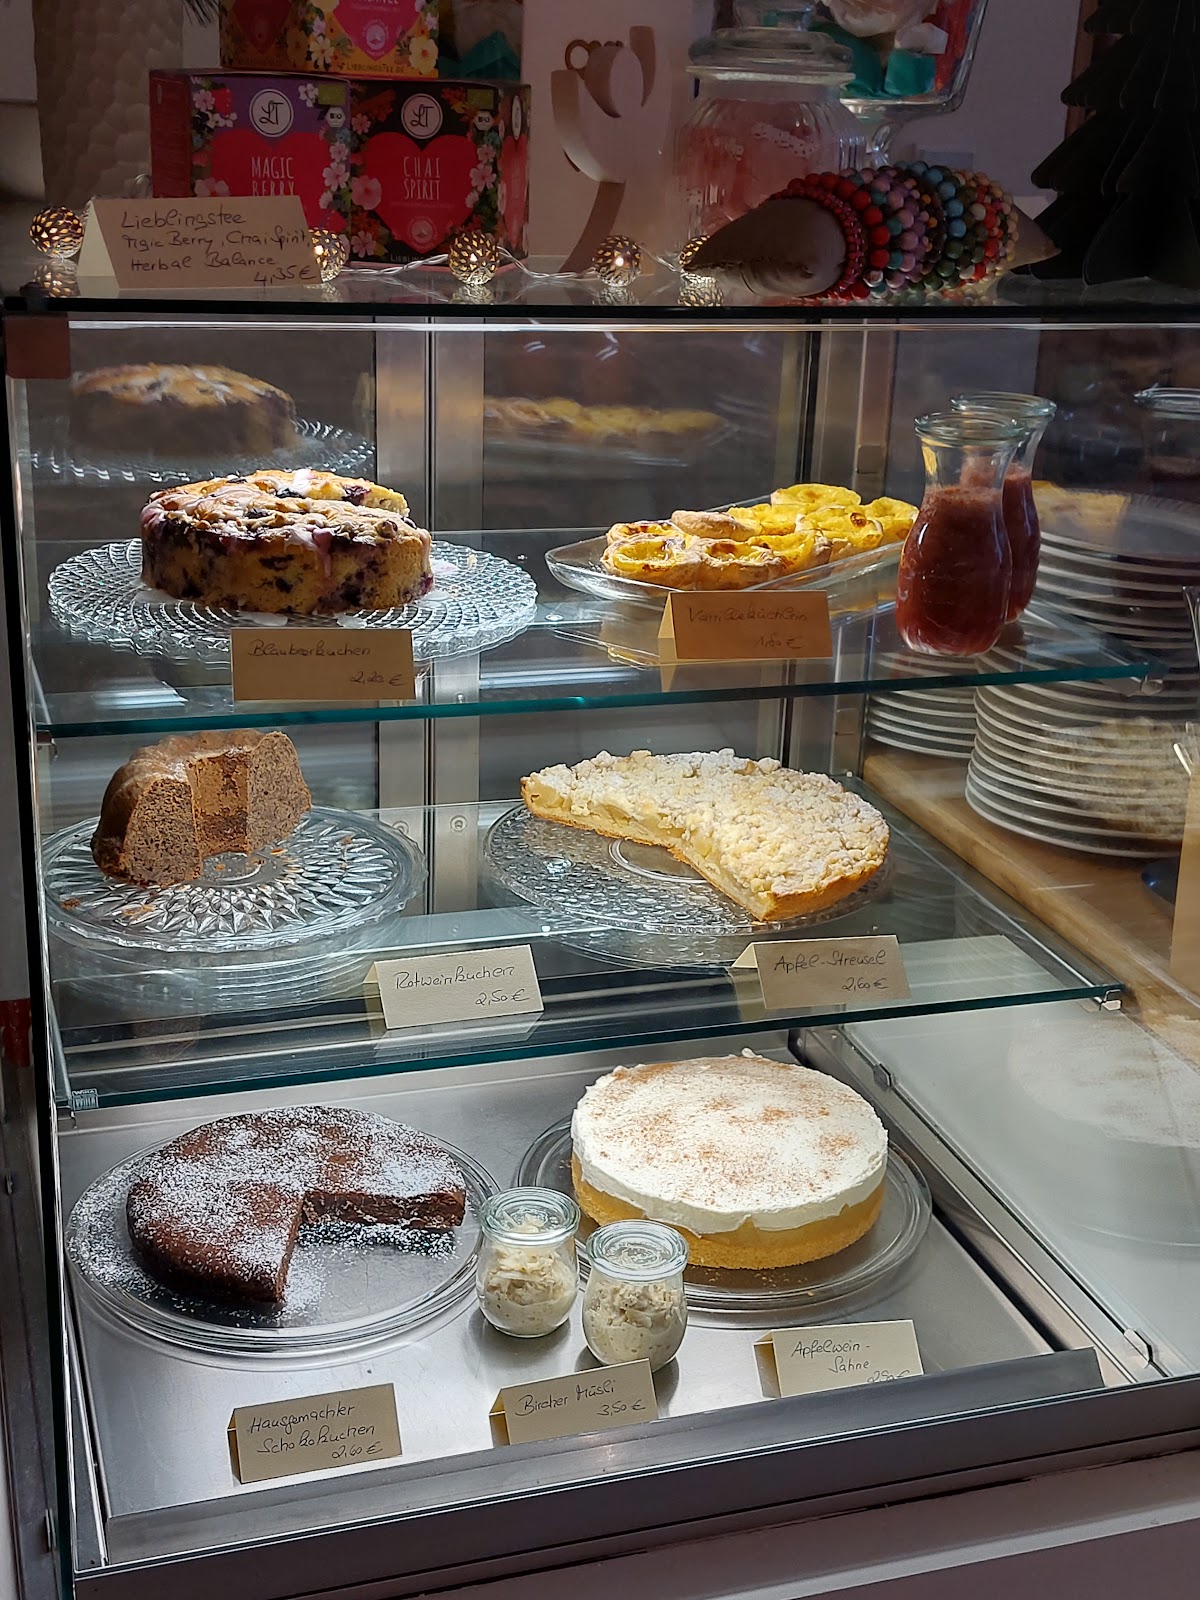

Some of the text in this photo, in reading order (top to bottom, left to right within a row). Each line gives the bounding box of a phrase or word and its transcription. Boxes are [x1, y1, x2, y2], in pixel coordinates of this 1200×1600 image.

[251, 156, 295, 179] MAGIC
[403, 155, 441, 178] CHAI
[252, 181, 295, 197] BERRY
[403, 178, 441, 200] SPIRIT
[121, 204, 246, 231] Lieblingstee
[131, 251, 277, 272] Herbal Balance
[828, 1355, 871, 1374] Sahne
[514, 1379, 617, 1417] Bircher Müsli
[248, 1401, 356, 1434] Hausgemachter
